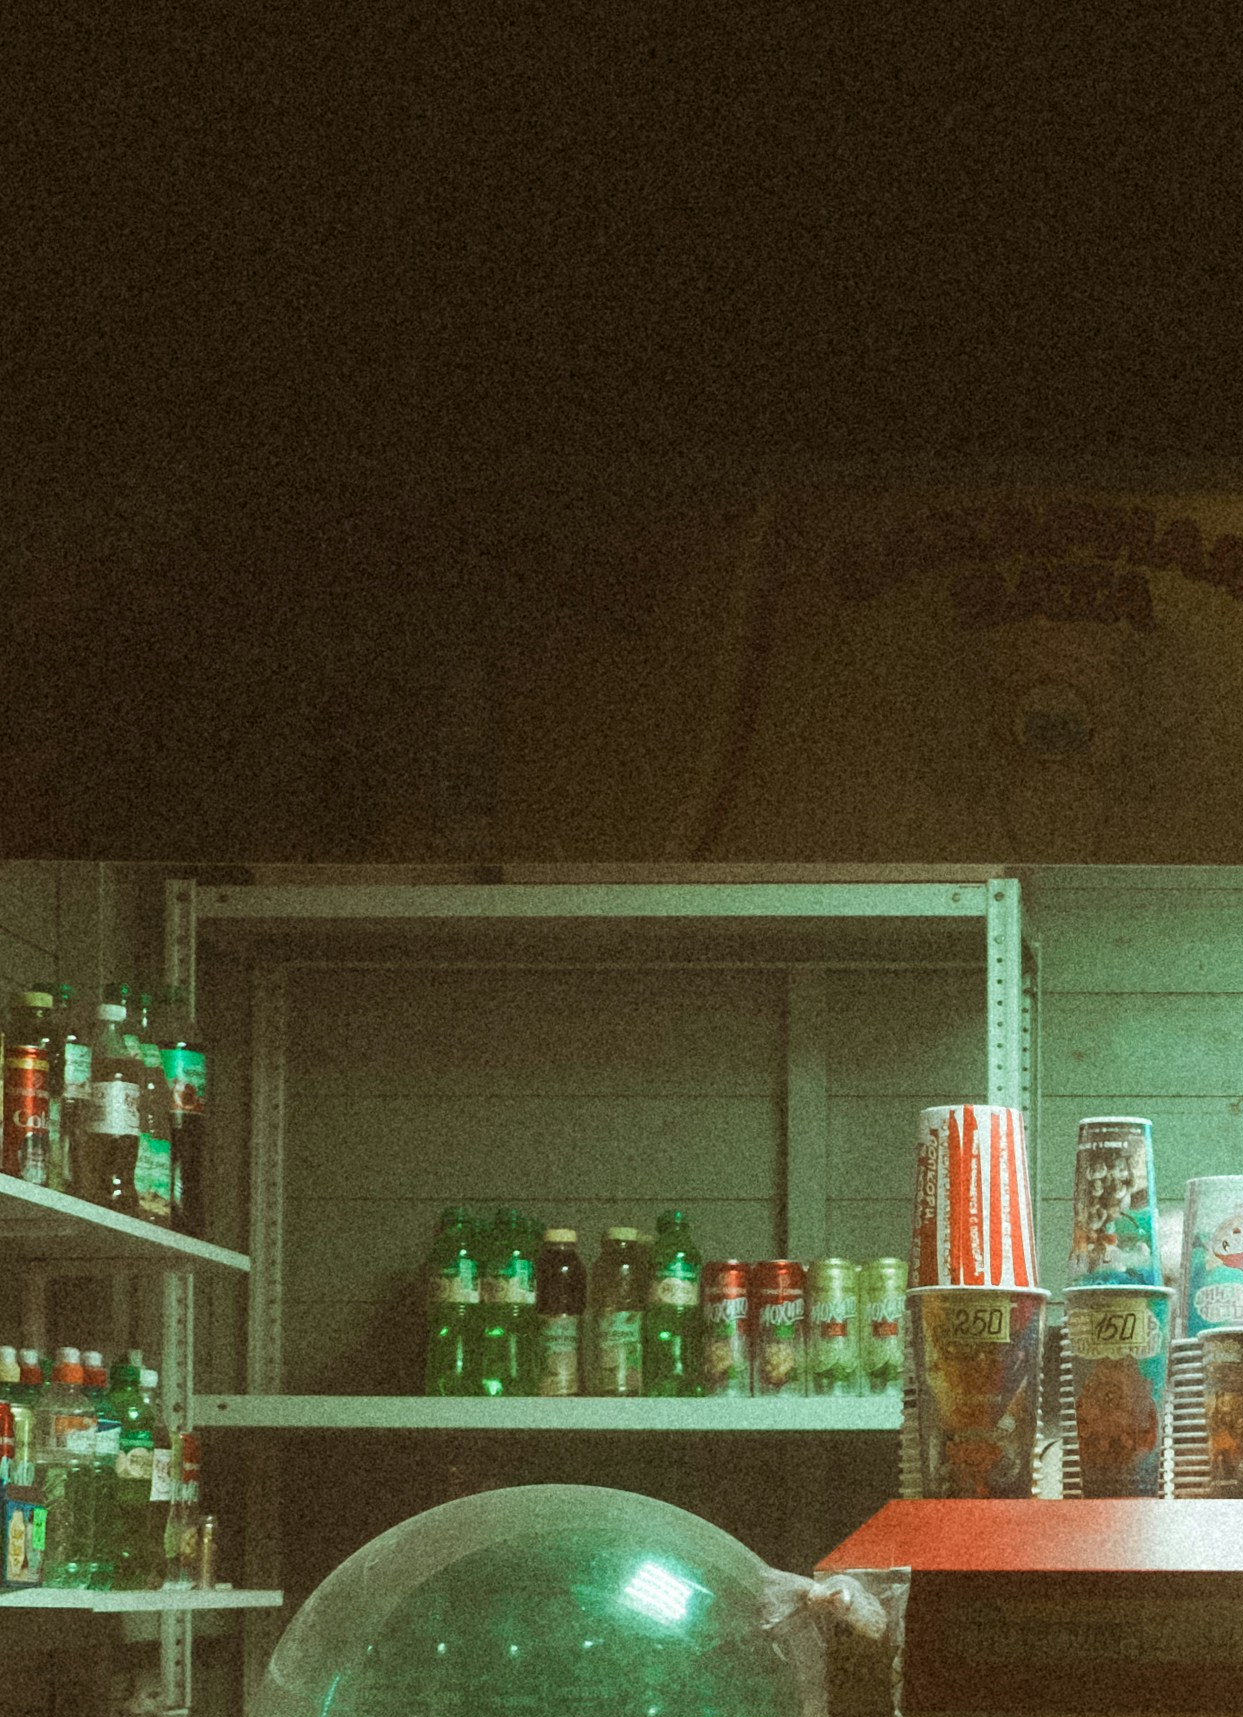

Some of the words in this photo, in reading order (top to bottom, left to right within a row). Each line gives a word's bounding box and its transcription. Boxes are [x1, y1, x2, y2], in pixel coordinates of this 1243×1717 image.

[13, 1109, 48, 1128] Col
[953, 1309, 1003, 1338] 250
[1097, 1312, 1139, 1342] 150
